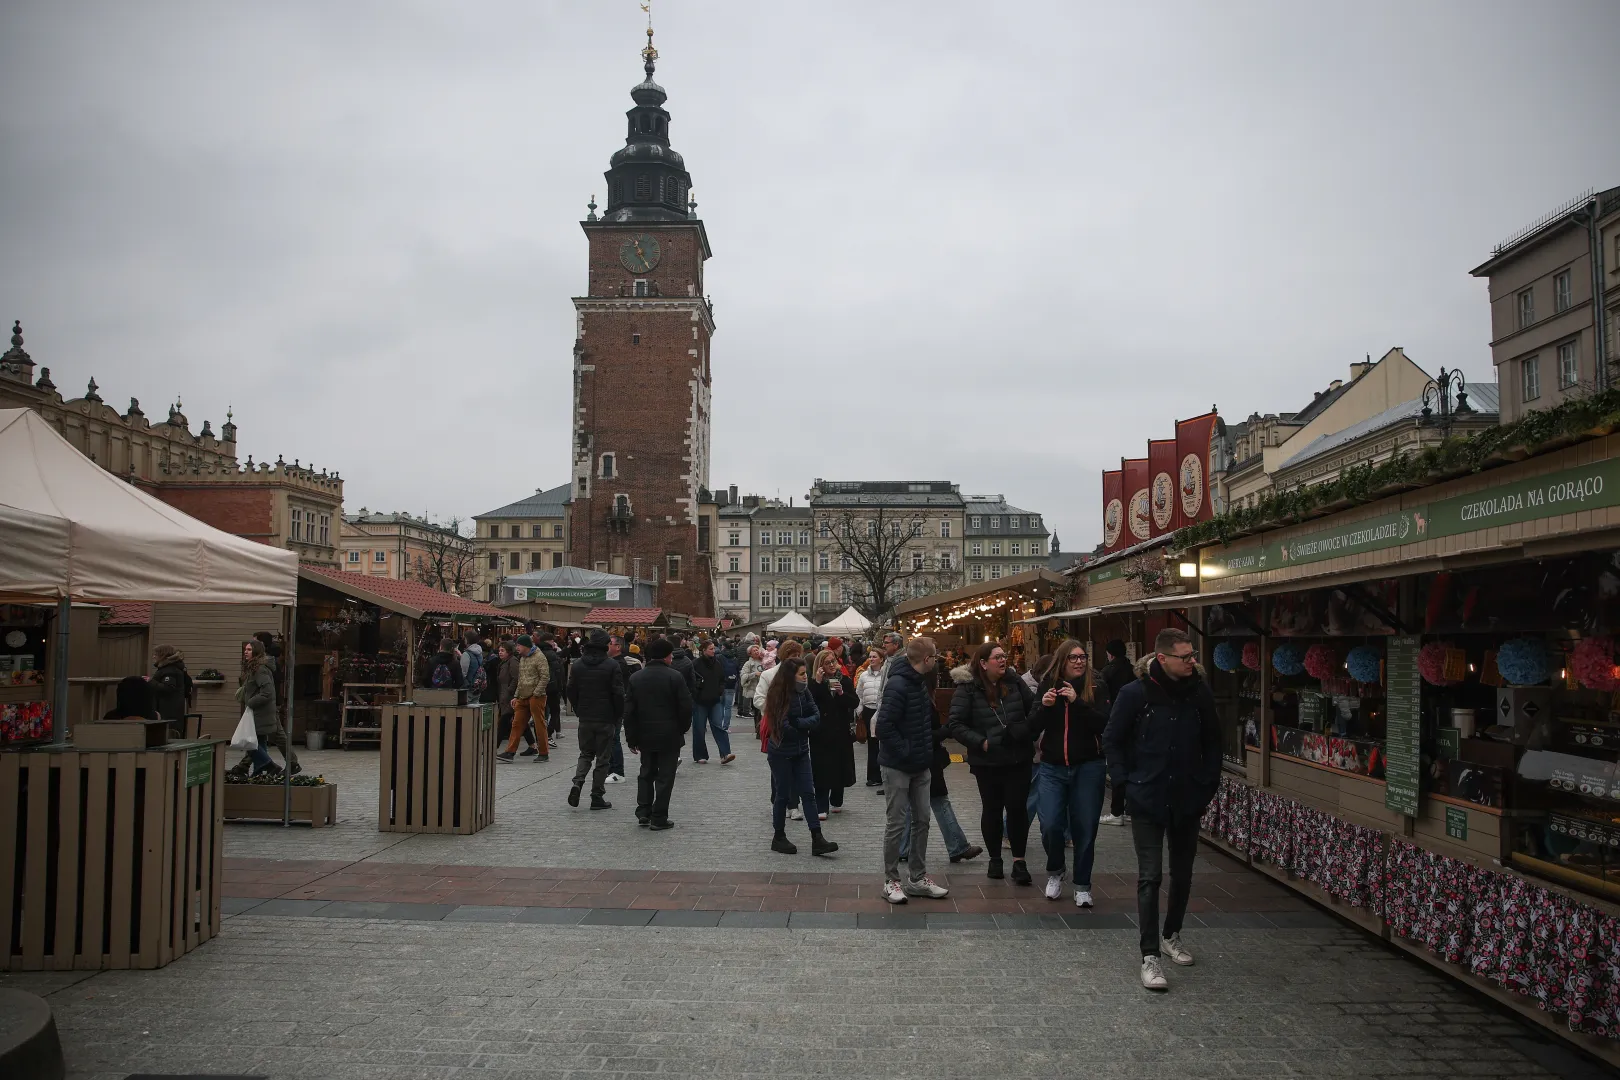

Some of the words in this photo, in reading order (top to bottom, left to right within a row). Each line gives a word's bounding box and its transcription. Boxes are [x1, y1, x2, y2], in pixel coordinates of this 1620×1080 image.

[1460, 493, 1523, 521] CZEKOLADA
[1527, 488, 1545, 508] NA
[1548, 475, 1603, 503] GORĄCO
[1296, 540, 1318, 557] ŚWIEŻE
[1318, 537, 1341, 553] OWOCE
[1341, 535, 1349, 547] W
[1349, 522, 1397, 546] CZEKOLADZIE
